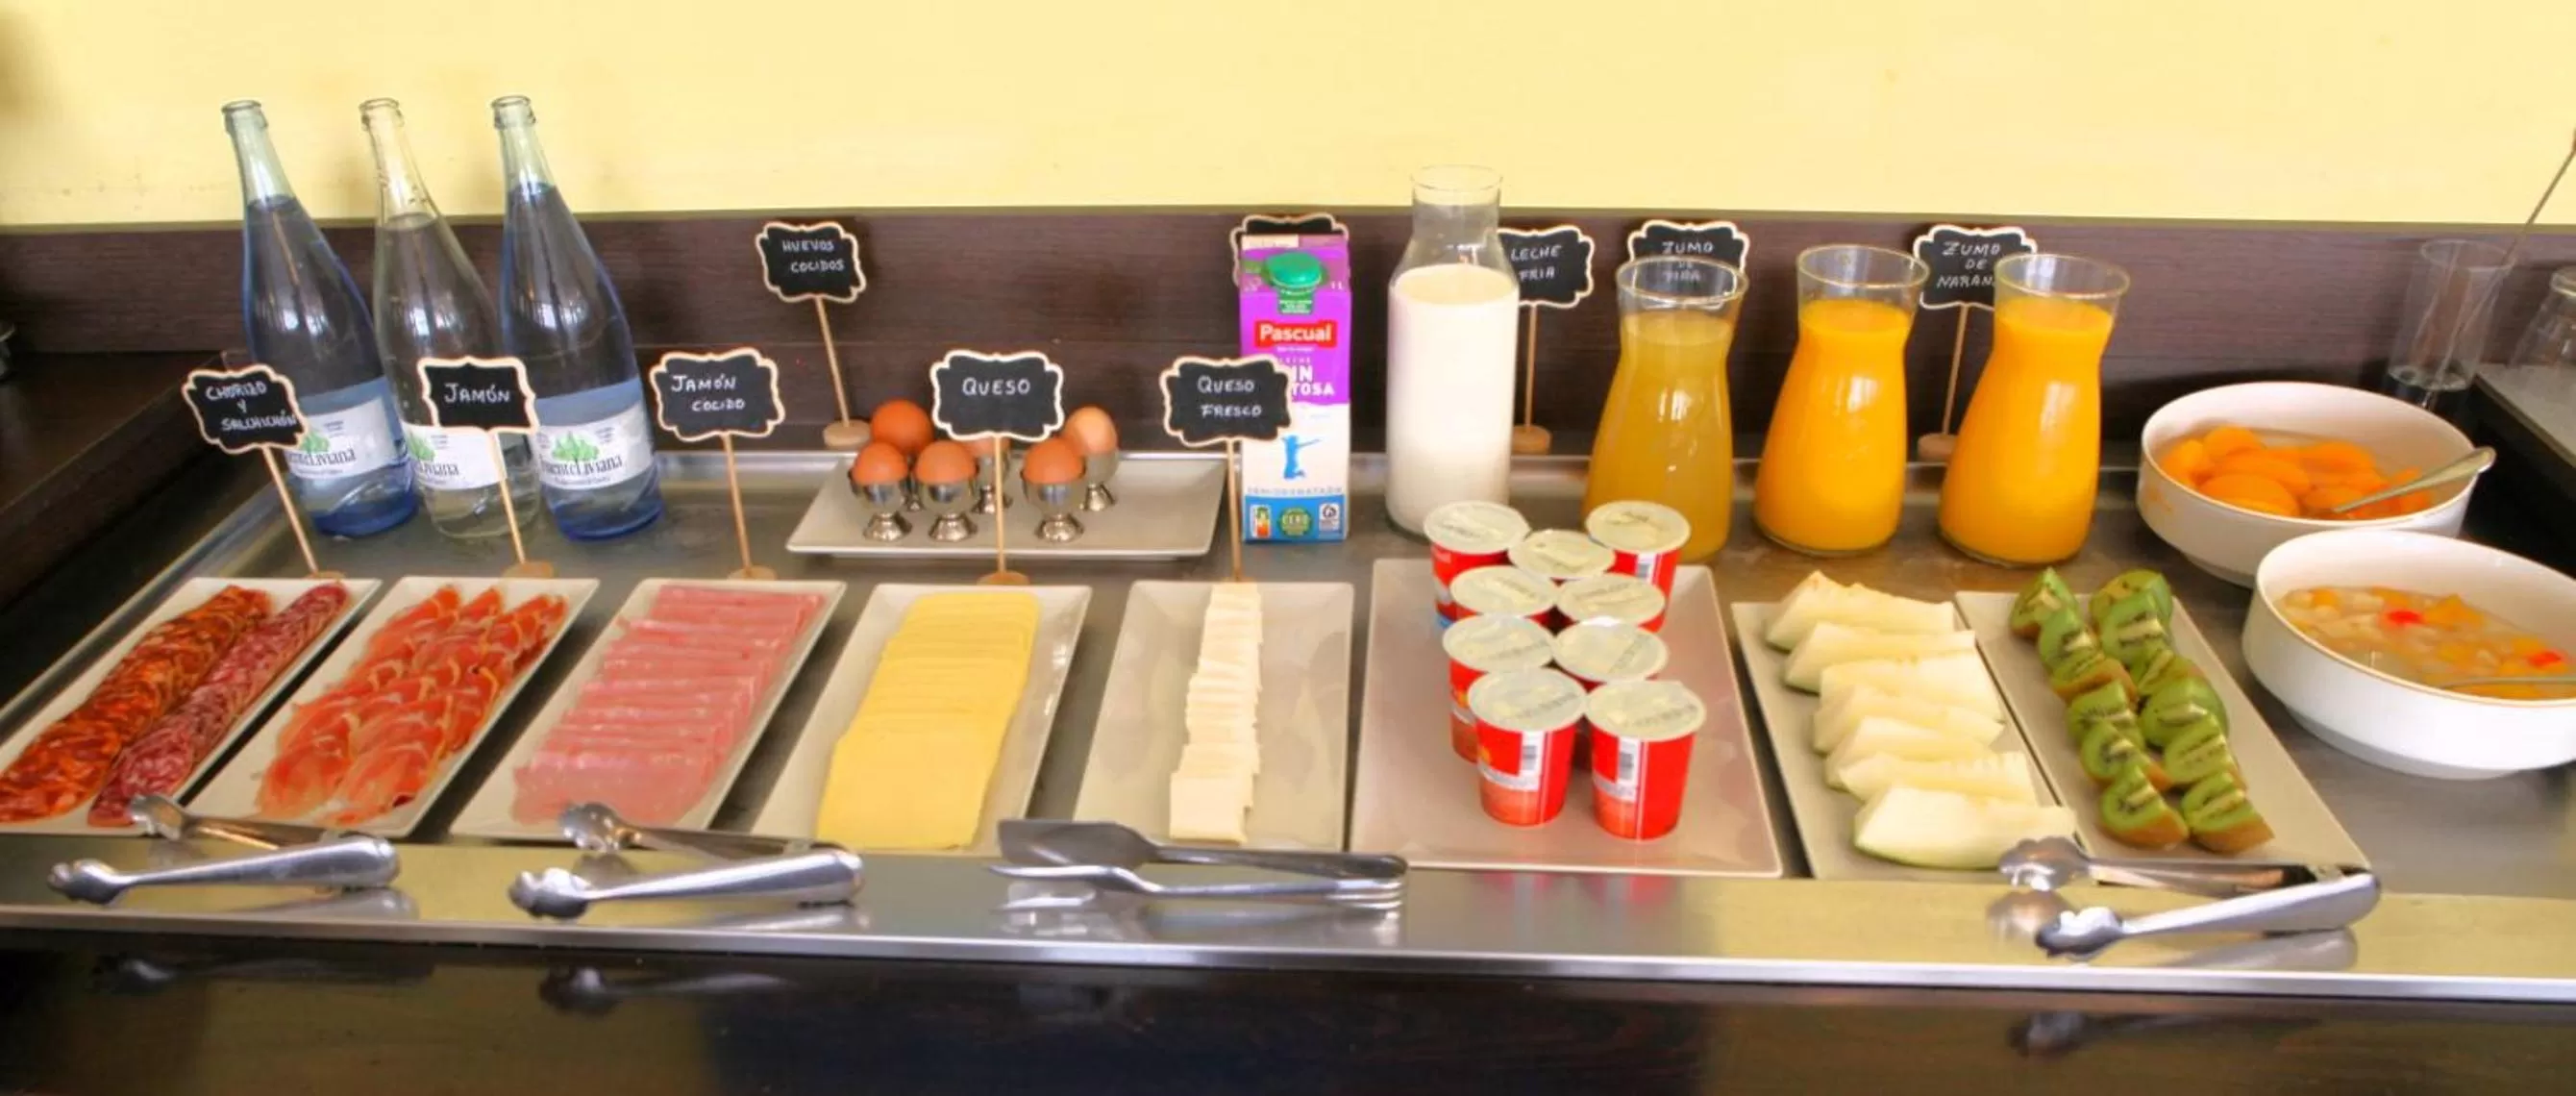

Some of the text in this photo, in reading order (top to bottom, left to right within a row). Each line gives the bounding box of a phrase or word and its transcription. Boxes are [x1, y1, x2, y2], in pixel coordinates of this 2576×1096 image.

[781, 239, 835, 254] HUEVOS
[1510, 244, 1562, 262] LECHE
[1662, 240, 1714, 255] ZUMO
[1942, 241, 2001, 257] ZUMO
[790, 260, 845, 274] COCIDOS
[1964, 259, 1989, 270] DE
[1936, 274, 1996, 289] NARAN
[1259, 322, 1332, 342] Pascual
[1291, 365, 1313, 382] IN
[670, 373, 737, 392] JAMÓN
[961, 378, 1031, 397] QUESO
[1198, 376, 1254, 394] QUESO
[1291, 382, 1335, 396] TOSA
[206, 381, 267, 401] CHORIZO
[444, 382, 510, 404] JAMÓN
[691, 398, 746, 412] COCIDO
[1201, 404, 1262, 418] FRESCO
